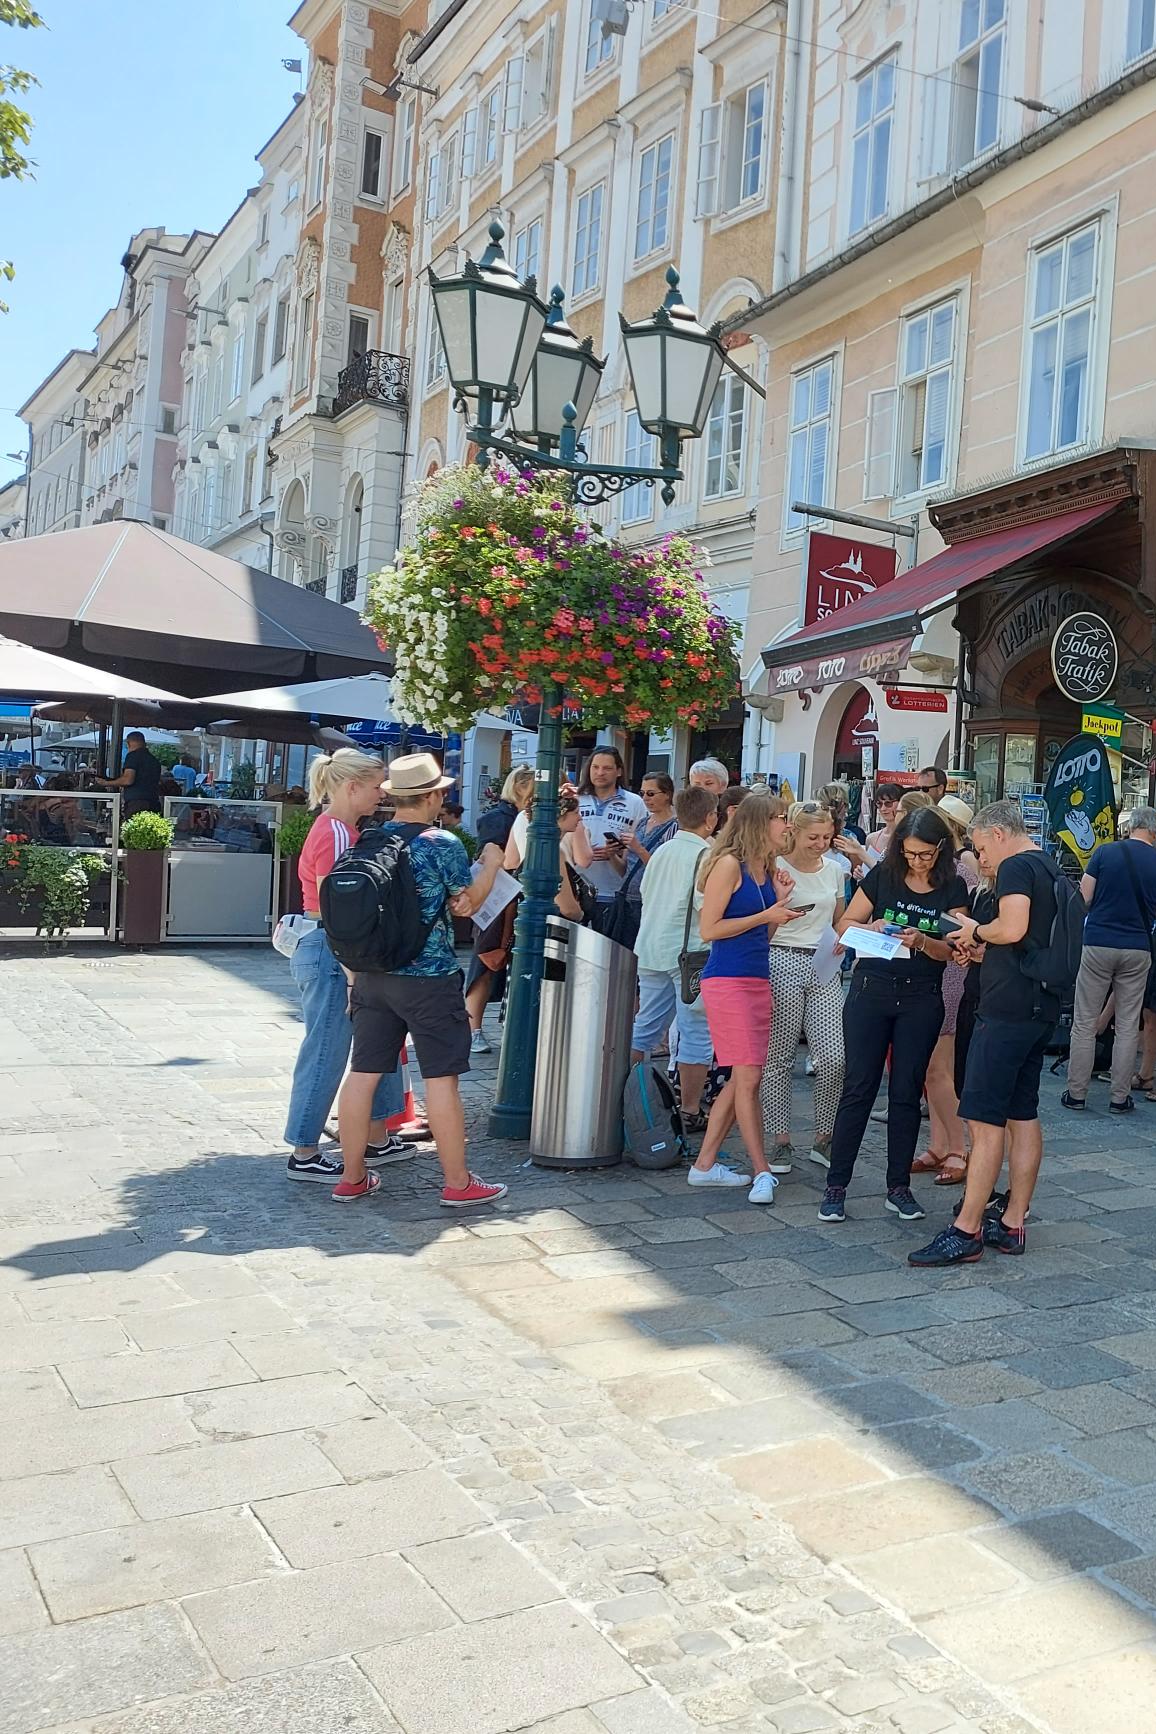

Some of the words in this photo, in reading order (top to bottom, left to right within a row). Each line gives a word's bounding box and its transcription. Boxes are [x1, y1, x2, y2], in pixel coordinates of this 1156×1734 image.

[818, 584, 862, 608] LIN
[1059, 632, 1113, 664] Tabak
[817, 657, 846, 680] TOTO
[1057, 653, 1110, 686] Trafik
[903, 700, 945, 708] LOTTERIEN
[1084, 716, 1119, 733] Jackpot
[1053, 748, 1101, 788] LOTTO
